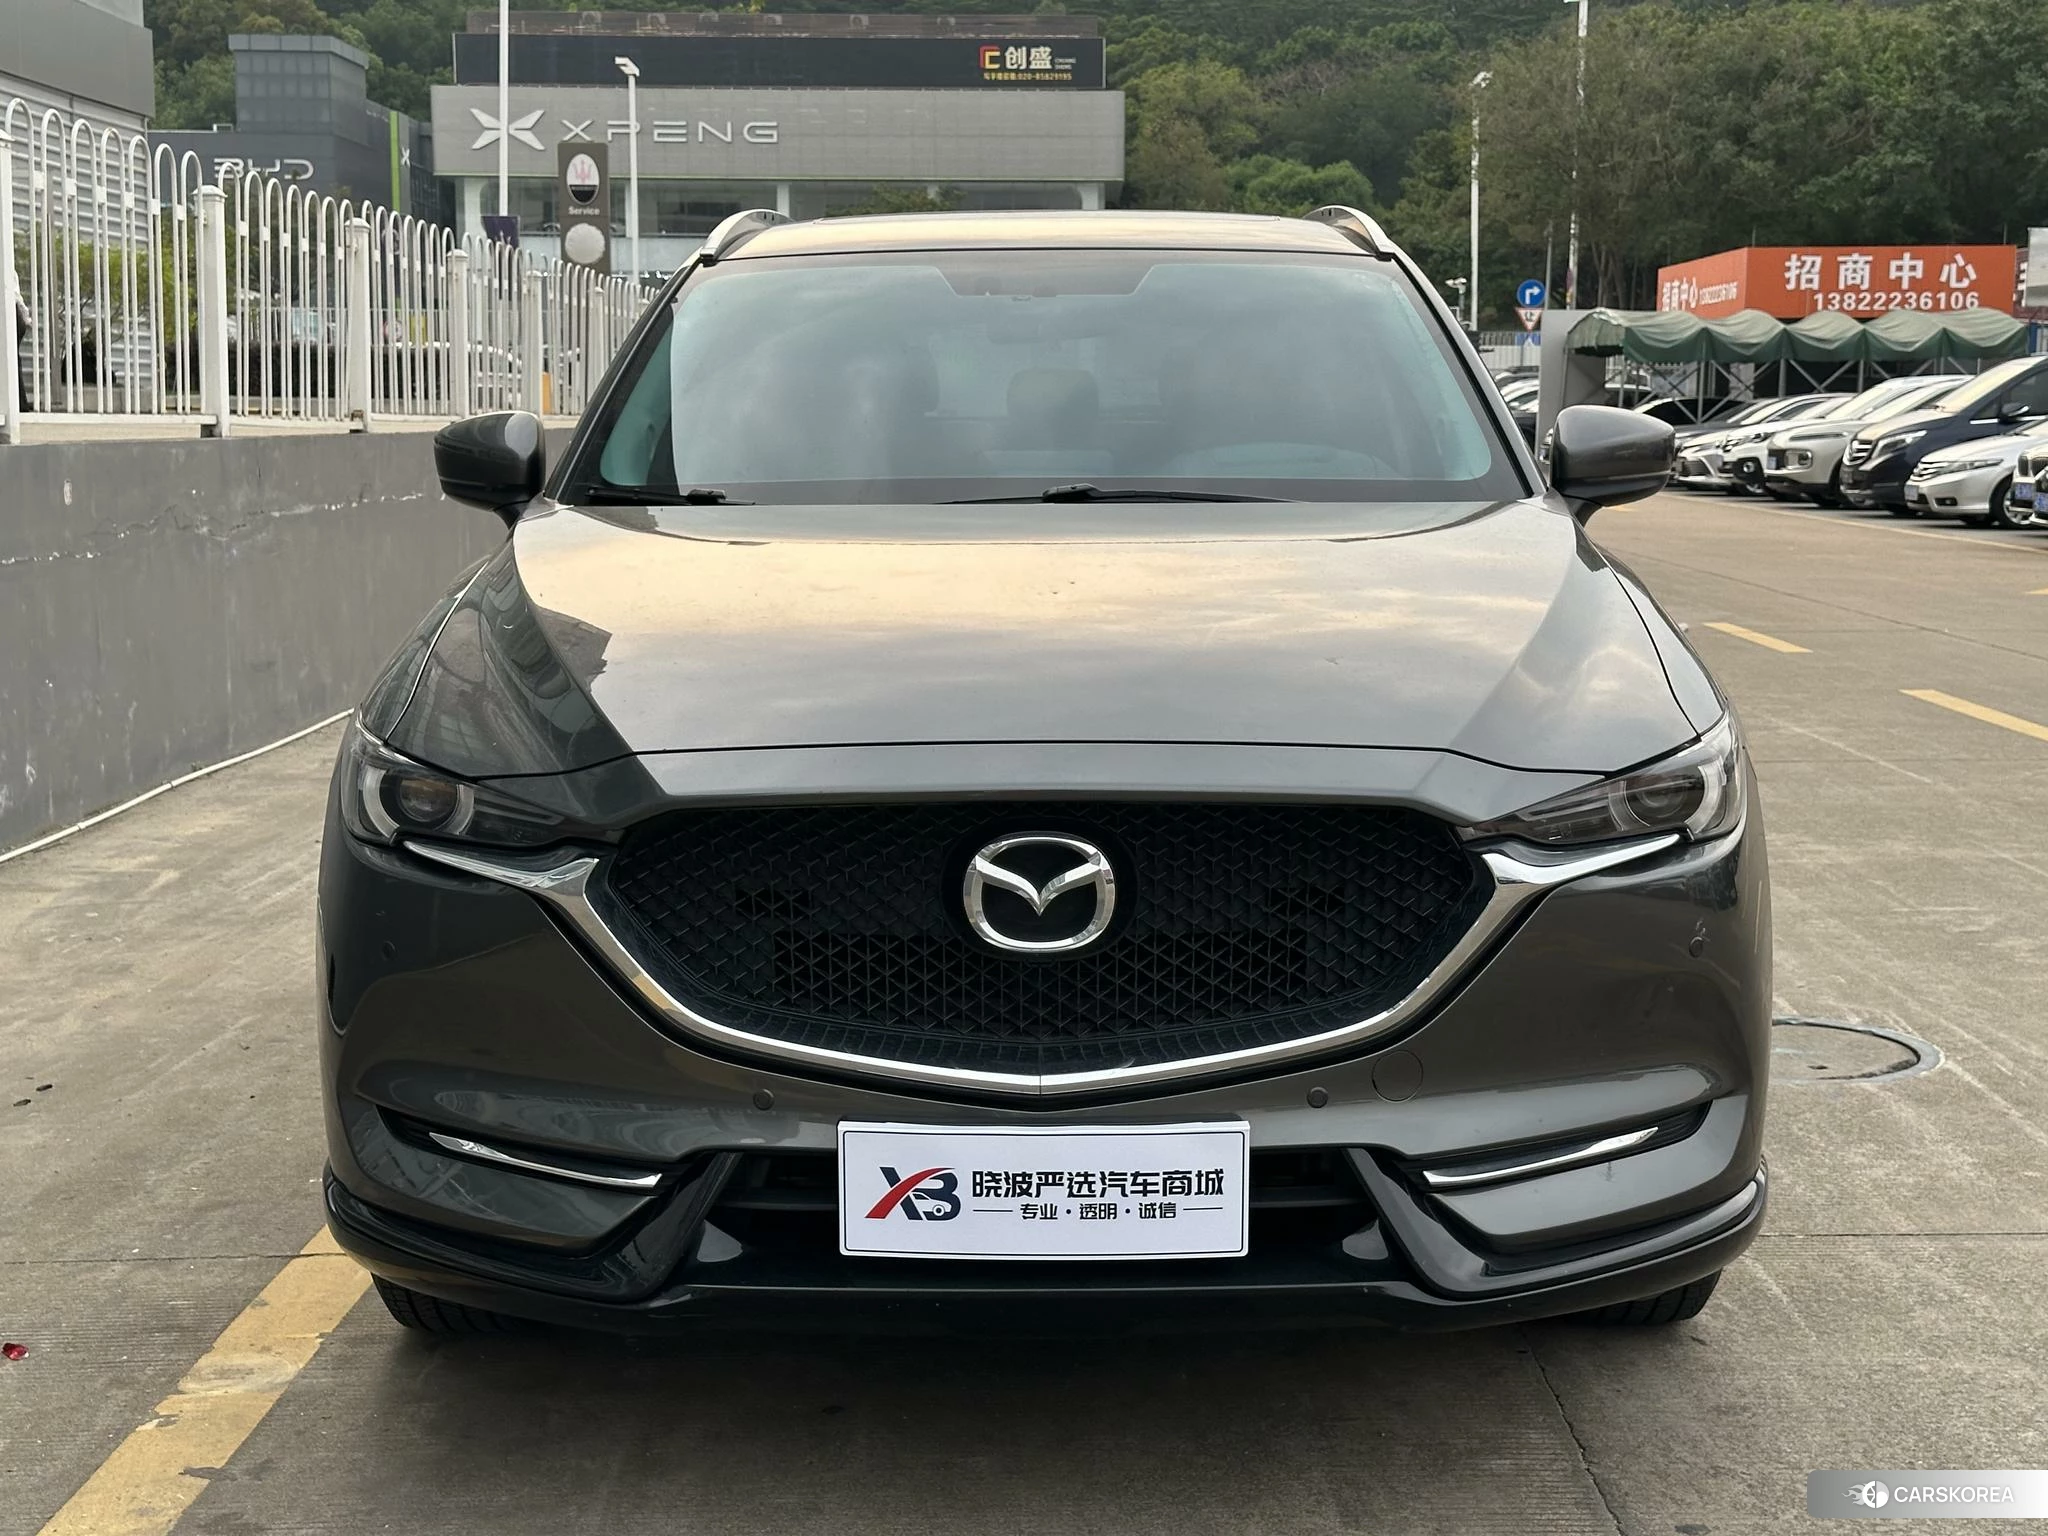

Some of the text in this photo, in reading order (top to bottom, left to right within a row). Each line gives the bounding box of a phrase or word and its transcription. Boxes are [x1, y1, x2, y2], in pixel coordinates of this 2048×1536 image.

[1004, 46, 1053, 70] 创盛
[561, 119, 779, 144] XPENG
[213, 158, 314, 180] BYD
[568, 206, 600, 216] Service
[1784, 252, 1977, 290] 招商中心
[1814, 292, 1980, 311] 13822236106
[972, 1168, 1224, 1199] 晓波严选汽车商城
